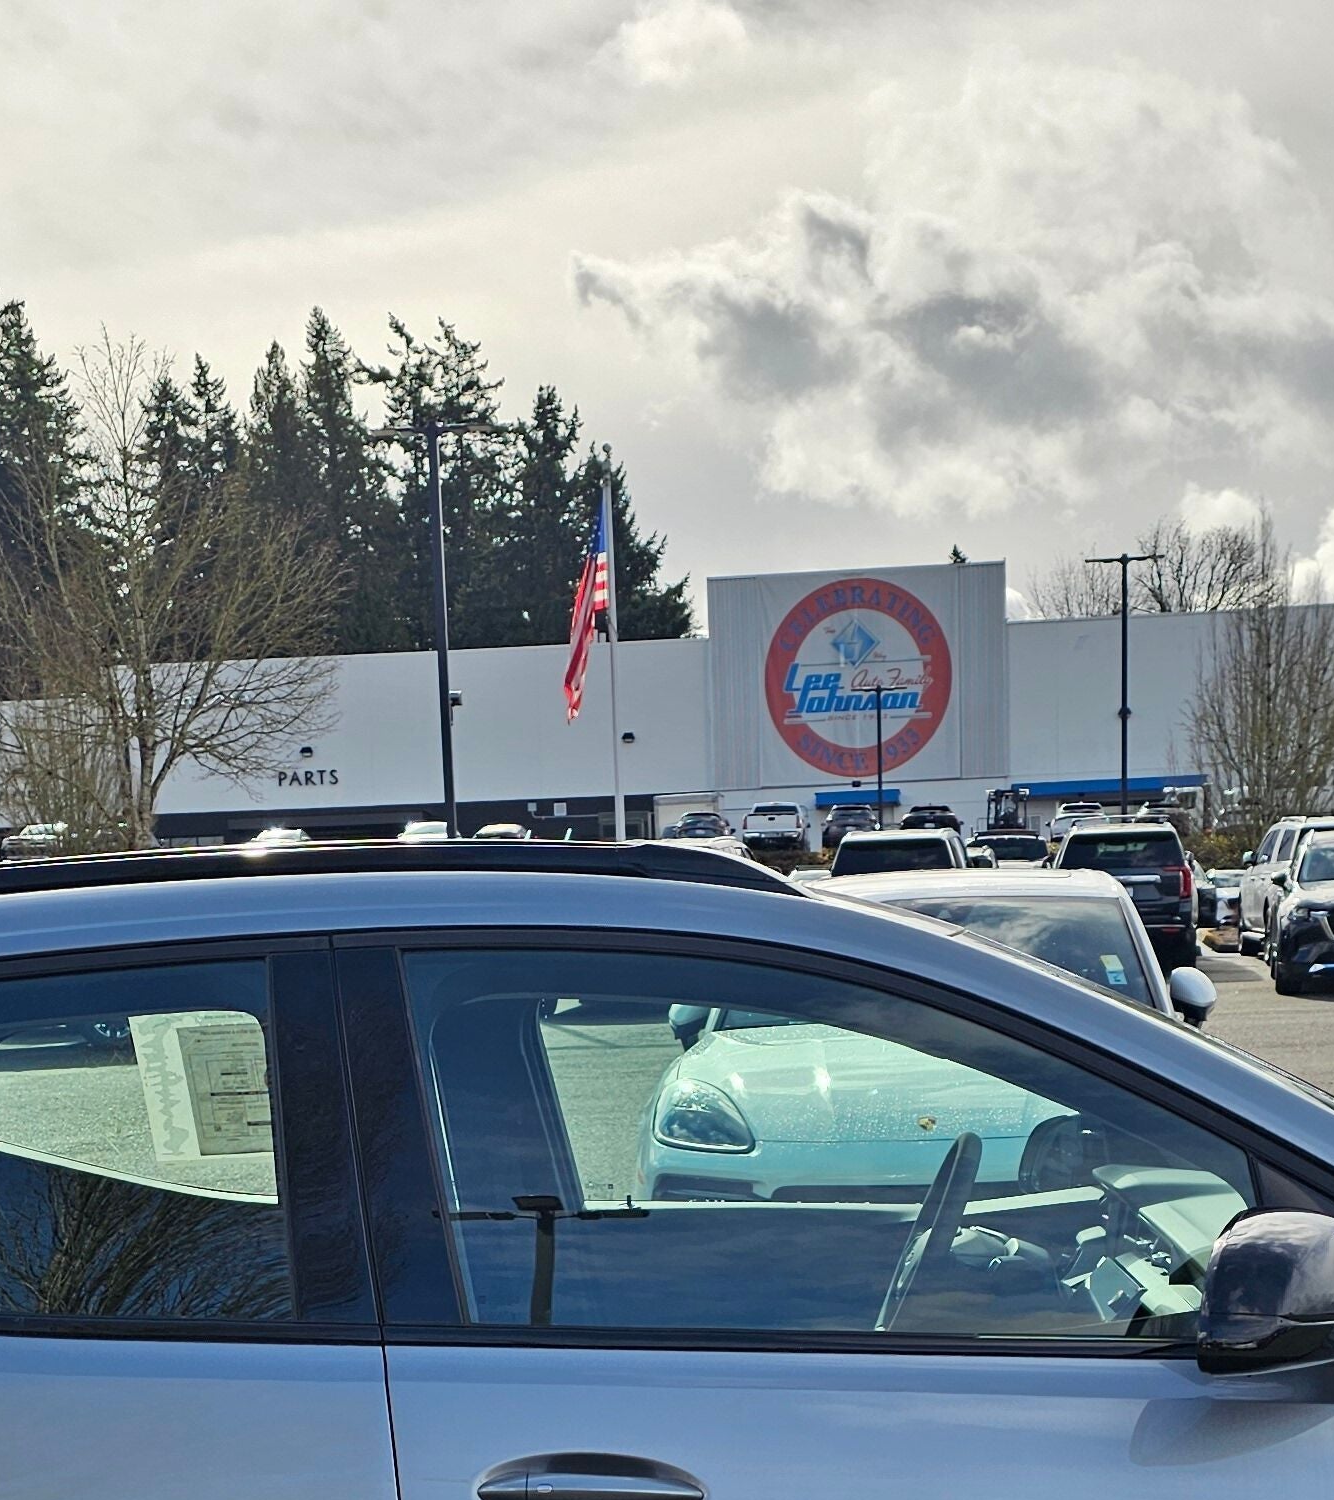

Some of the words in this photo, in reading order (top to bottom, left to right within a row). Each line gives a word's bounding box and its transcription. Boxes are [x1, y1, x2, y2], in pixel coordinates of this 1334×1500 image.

[779, 585, 939, 652] CELEBRATING
[784, 662, 844, 691] Lee
[851, 668, 885, 688] Auto
[886, 665, 934, 690] Family
[794, 686, 922, 714] Johnson
[863, 713, 888, 721] 193
[797, 733, 867, 771] SINCE
[277, 769, 339, 787] PARTS
